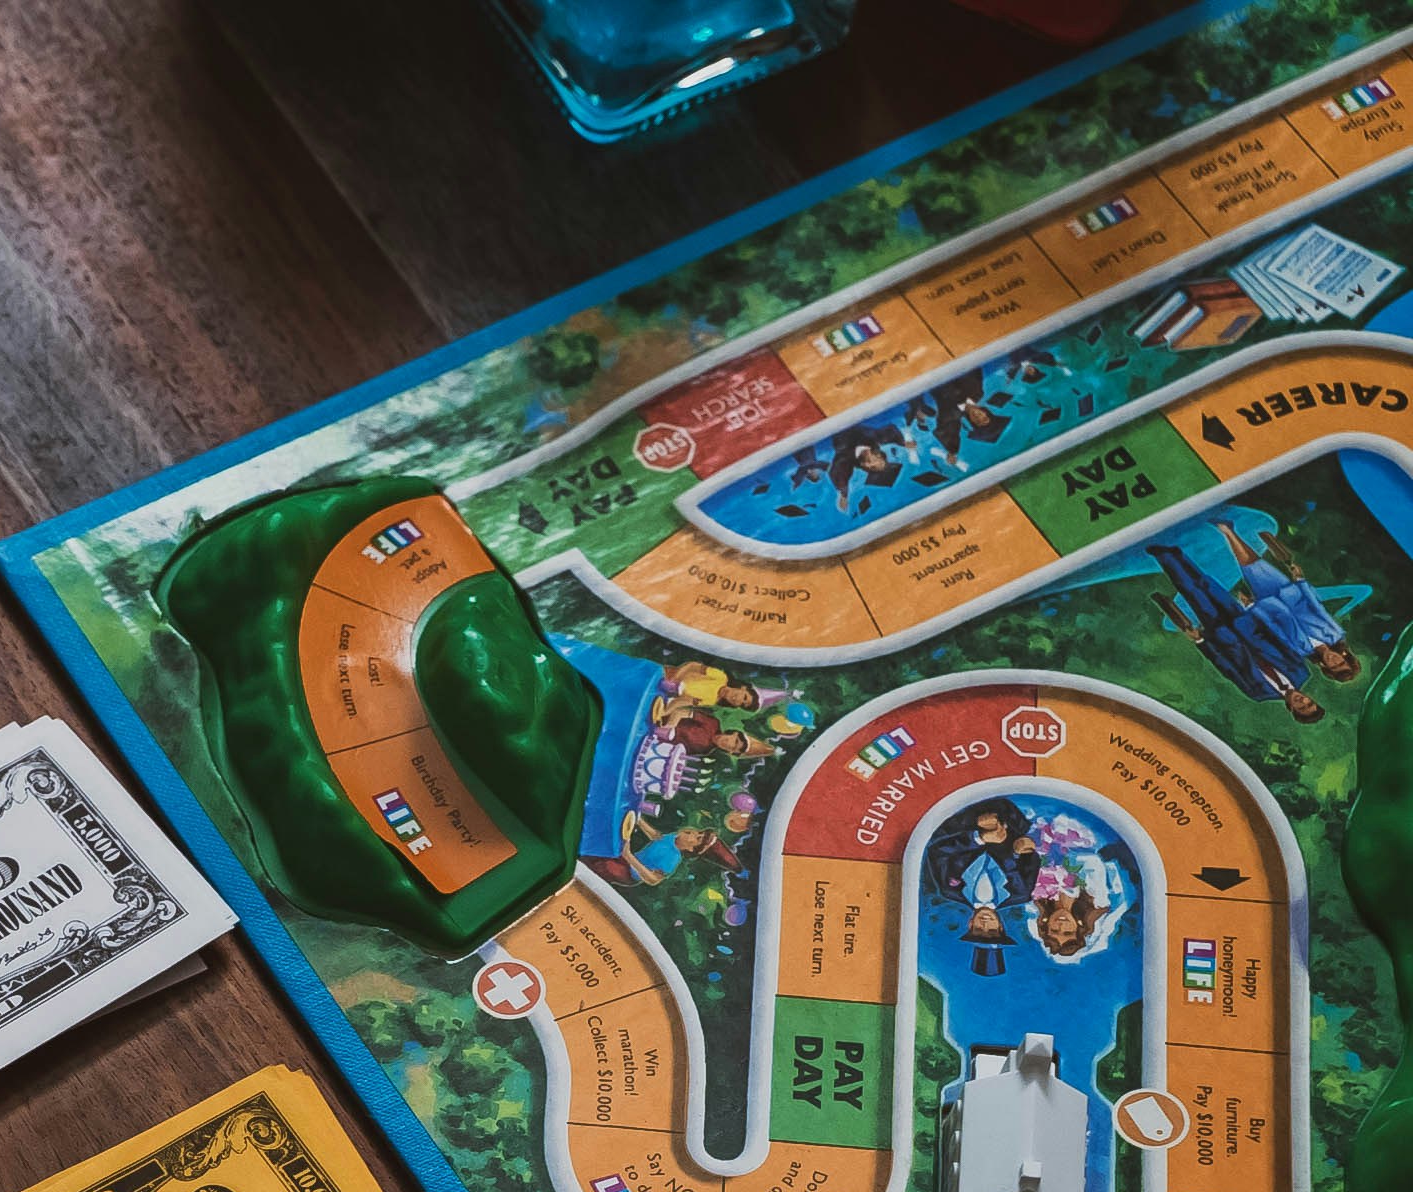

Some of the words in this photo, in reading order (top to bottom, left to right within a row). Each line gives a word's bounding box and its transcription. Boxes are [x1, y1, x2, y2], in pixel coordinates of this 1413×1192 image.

[692, 375, 773, 421] SEARCH
[726, 399, 767, 432] JOB
[1236, 382, 1409, 426] CAREER
[645, 431, 687, 461] STOP
[1062, 446, 1137, 497] DAY
[1085, 472, 1157, 521] PAY
[361, 520, 422, 565] LIFE
[942, 523, 967, 540] Pay
[753, 585, 811, 602] Collect
[941, 568, 975, 588] Rent
[341, 624, 357, 650] Lose
[1009, 722, 1060, 741] STOP
[849, 727, 915, 780] LIFE
[940, 740, 991, 770] GET
[411, 755, 449, 808] Birthday
[446, 809, 482, 847] Party!
[856, 758, 936, 846] MARRIED
[1109, 732, 1171, 776] Wedding
[1171, 772, 1224, 834] reception.
[1111, 761, 1138, 783] Pay
[1140, 779, 1191, 827] $10,000
[376, 791, 433, 856] LIFE
[561, 905, 584, 926] Ski
[814, 880, 830, 909] Lose
[813, 912, 825, 943] next
[844, 905, 861, 929] Flat
[539, 922, 562, 945] Pay
[560, 945, 600, 989] $5,000
[811, 946, 823, 978] turn.
[1187, 941, 1213, 1004] LIFE
[1221, 935, 1238, 1017] honeymoon!
[1241, 958, 1262, 1000] Happy
[587, 1016, 608, 1063] Collect
[618, 1029, 640, 1096] marathon!
[644, 1048, 660, 1077] Win
[792, 1035, 824, 1110] DAY
[834, 1040, 864, 1111] PAY
[1193, 1086, 1212, 1108] Pay
[1196, 1113, 1214, 1166] $10,000
[1225, 1097, 1242, 1158] furniture.
[1245, 1117, 1265, 1144] Buy
[624, 1164, 639, 1180] to
[647, 1152, 666, 1178] Say
[781, 1160, 802, 1188] and
